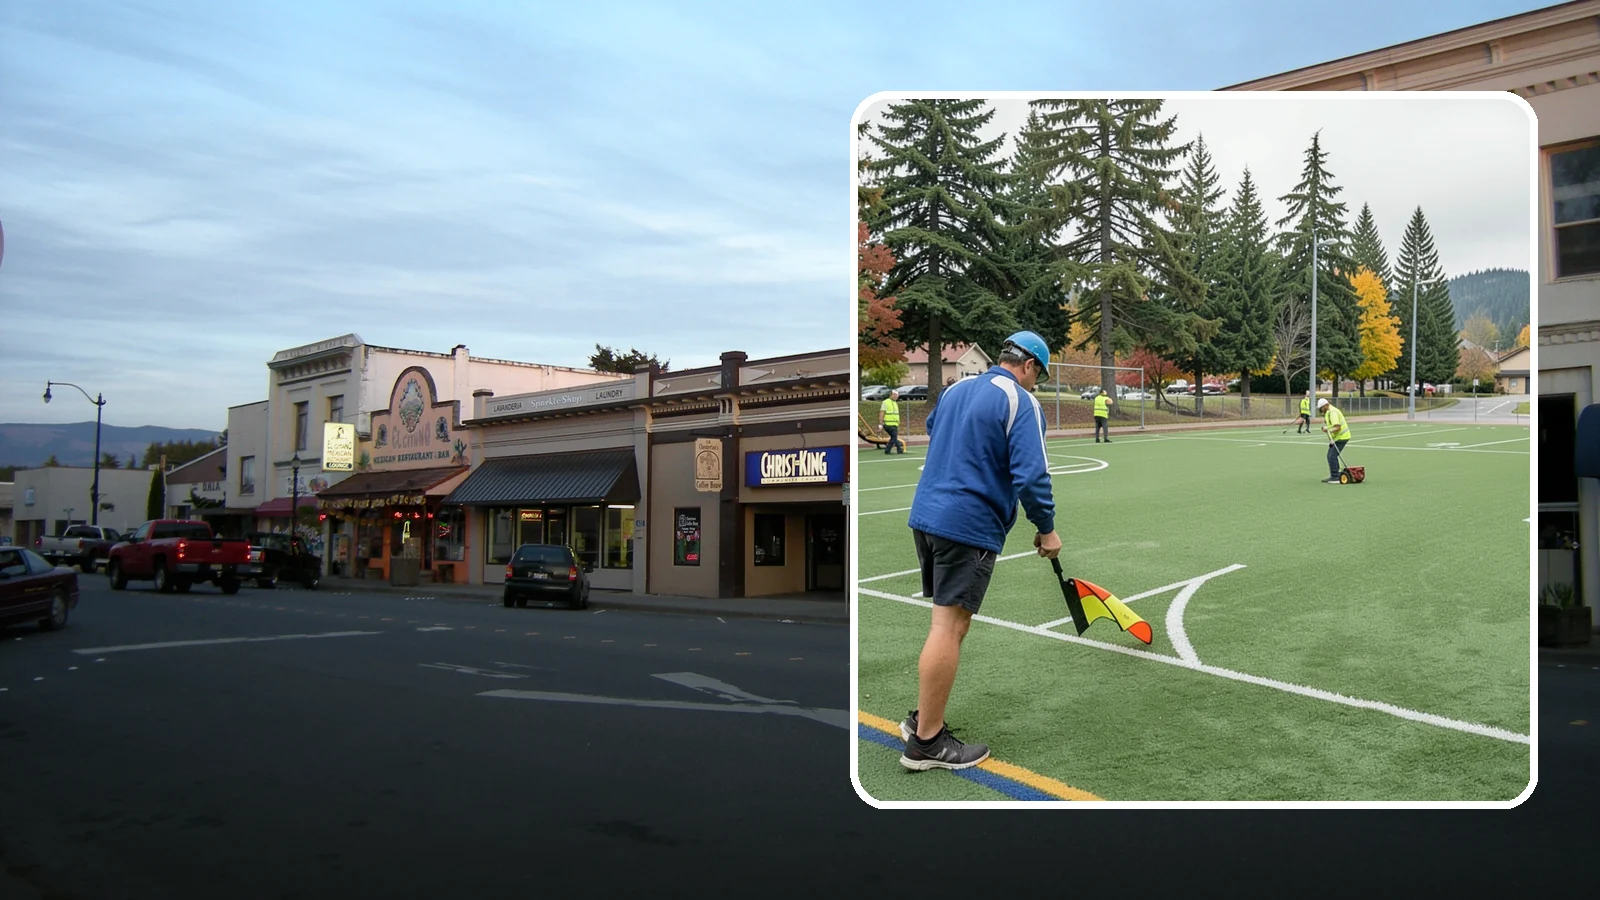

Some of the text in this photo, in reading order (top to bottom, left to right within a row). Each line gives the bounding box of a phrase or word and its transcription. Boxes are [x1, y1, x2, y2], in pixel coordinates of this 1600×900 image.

[595, 388, 623, 400] LAUNDRY
[493, 402, 523, 413] LAVANDERIA
[530, 393, 582, 410] Sparkle Shop
[373, 454, 396, 464] MEXICAN
[397, 451, 433, 462] RESTAURANT
[437, 450, 450, 459] BAR
[760, 450, 827, 477] CHRIST KING
